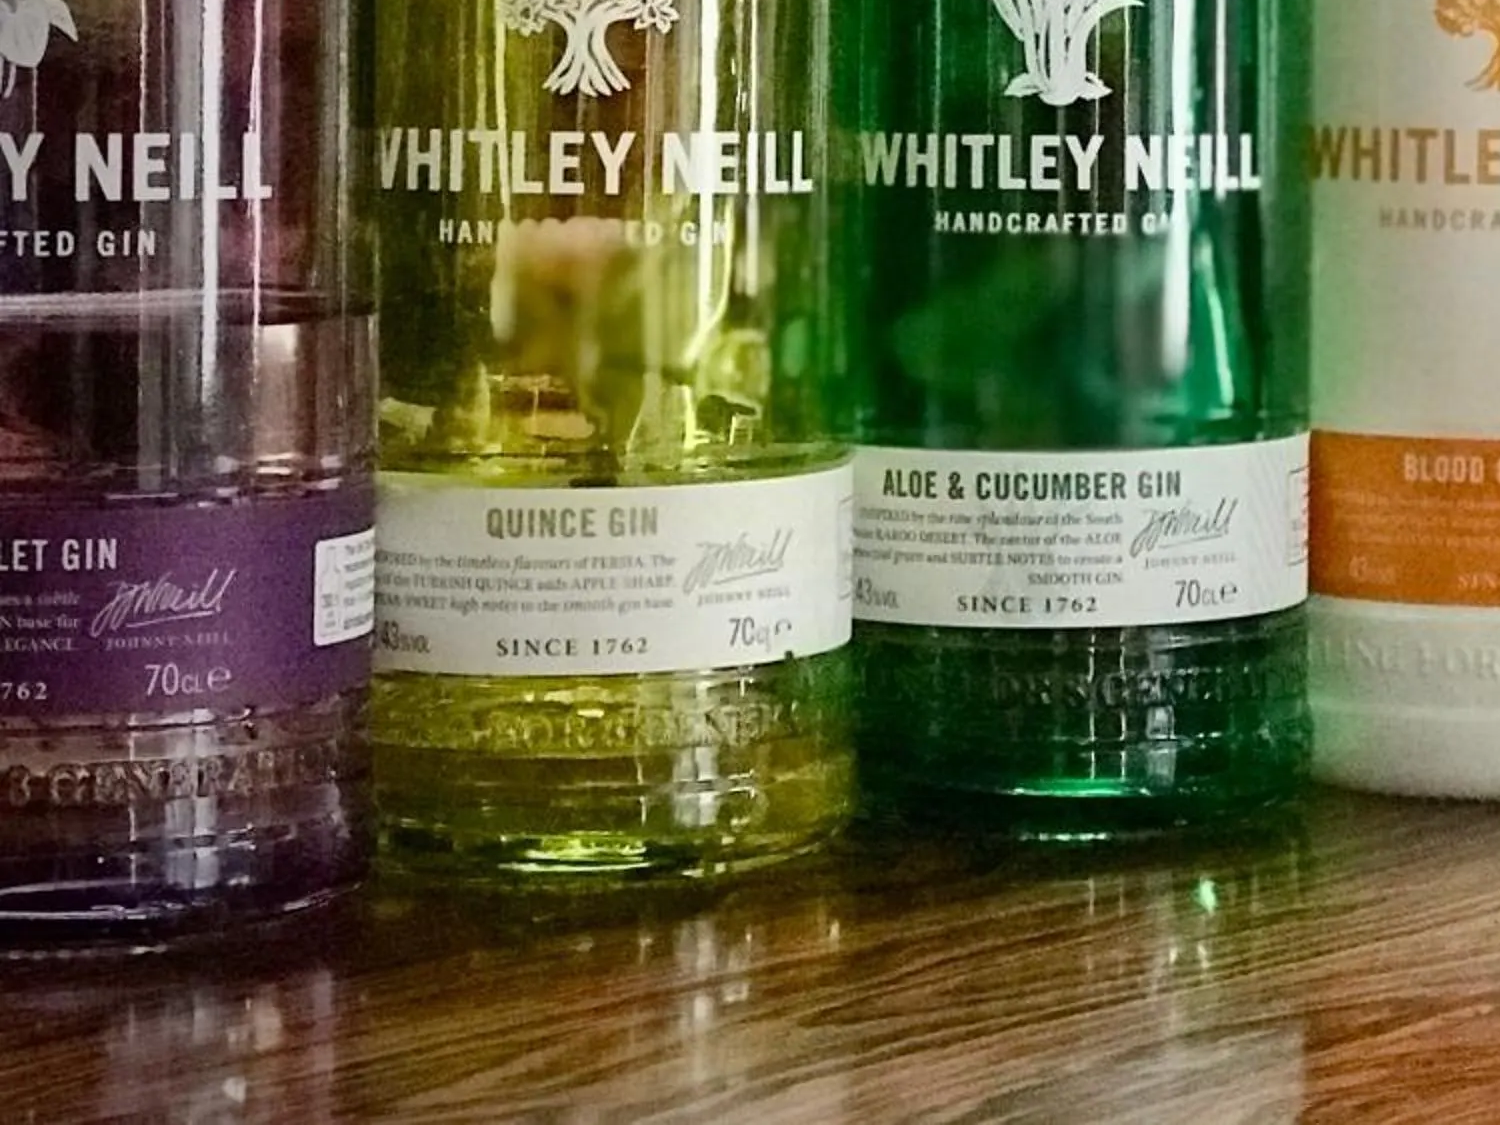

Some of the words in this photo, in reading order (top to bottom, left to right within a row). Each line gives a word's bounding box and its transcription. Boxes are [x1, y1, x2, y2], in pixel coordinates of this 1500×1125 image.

[75, 132, 273, 202] NEILL
[662, 131, 813, 194] NEILL
[860, 131, 1105, 191] WHITLEY
[1125, 133, 1261, 191] NEILL
[935, 211, 1127, 234] HANDCRAFTED
[97, 230, 157, 257] GIN
[883, 469, 938, 500] ALOE
[948, 471, 965, 501] &
[976, 471, 1127, 501] CUCUMBER
[1138, 470, 1181, 499] GIN
[1404, 453, 1484, 485] BLOOD
[487, 507, 595, 539] QUINCE
[609, 507, 658, 537] GIN
[62, 538, 117, 572] GIN
[957, 596, 1032, 614] SINCE
[1045, 596, 1097, 614] 1762
[496, 638, 579, 657] SINCE
[592, 637, 649, 656] 1762
